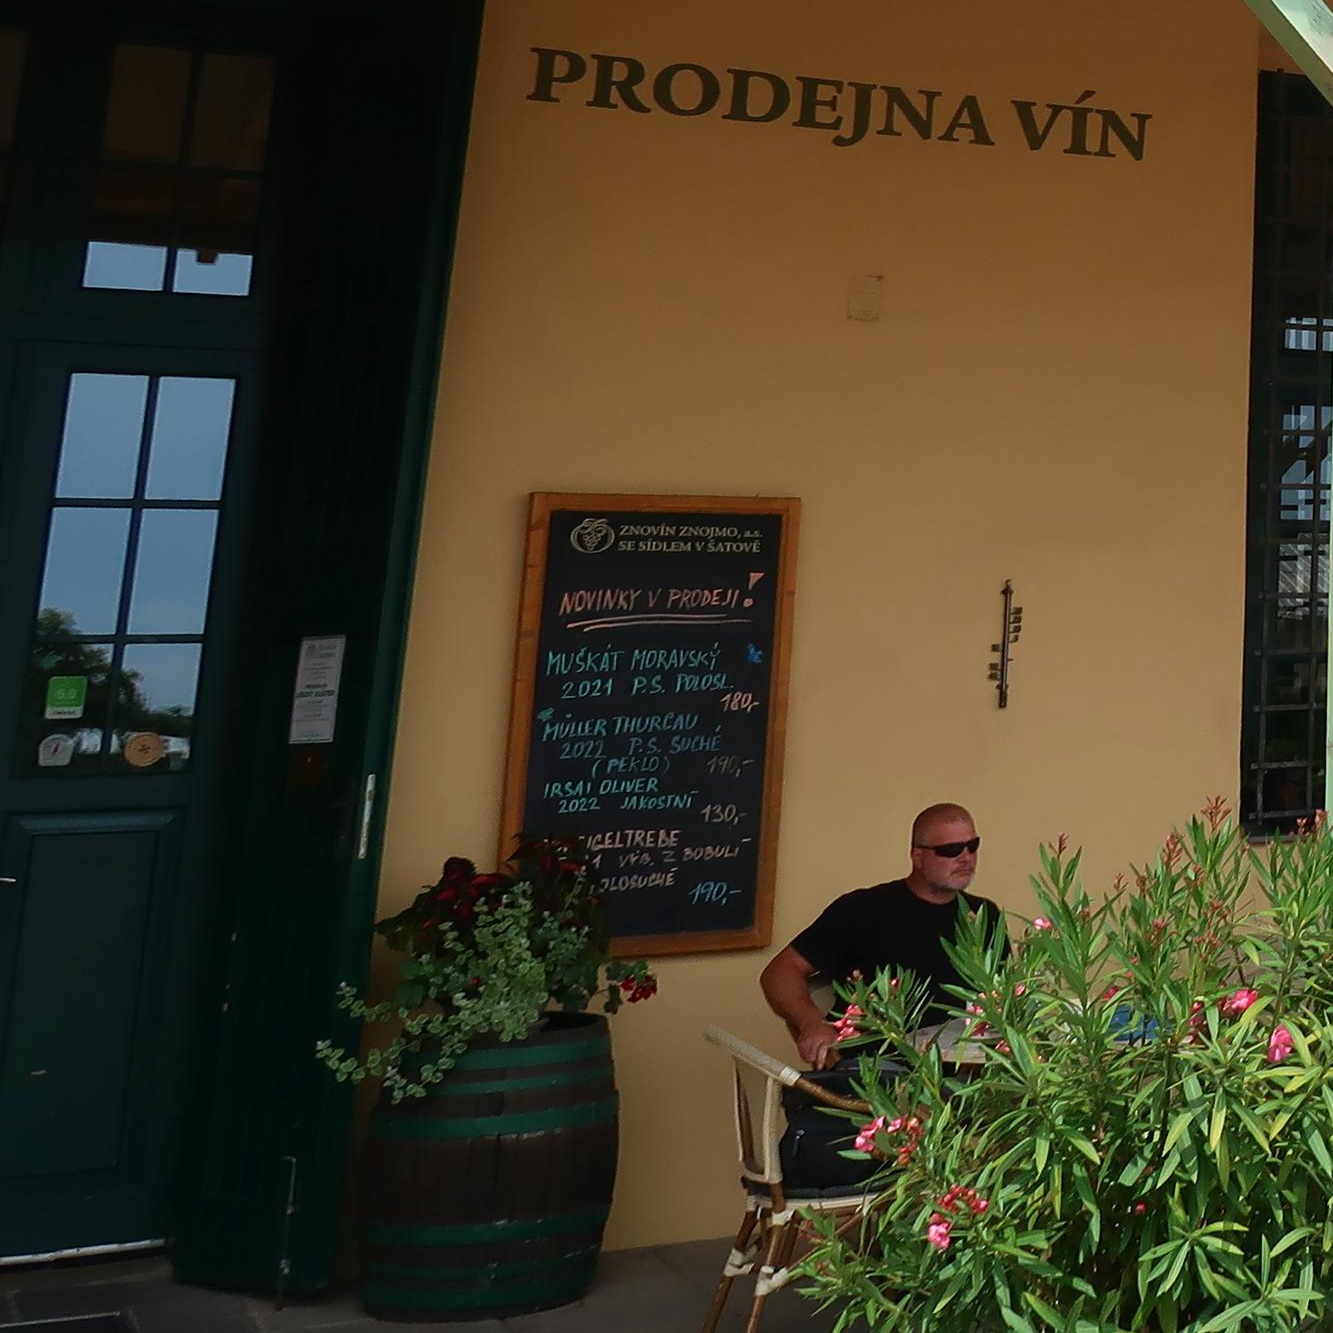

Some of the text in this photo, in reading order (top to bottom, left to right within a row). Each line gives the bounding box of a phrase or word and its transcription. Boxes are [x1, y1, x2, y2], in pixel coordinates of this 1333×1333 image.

[526, 46, 1153, 162] PRODEJNA VÍN
[619, 522, 764, 540] ZNOVÍN ZNOJMO, a.s.
[617, 538, 762, 554] SE SÍDLEM V ŠATOVĚ
[558, 588, 643, 616] NOVINKY
[648, 589, 661, 608] V
[546, 641, 721, 676] MUŠKÁT MORAVSKÝ
[561, 672, 735, 700] 2021 P.S. POLOSL.
[559, 724, 723, 760] 2022 P.S. SUCHÉ
[542, 777, 660, 799] IRSAI OLIVER
[557, 789, 700, 814] 2022 JAKOSTNÍ
[589, 866, 680, 896] OLOSUCHÉ
